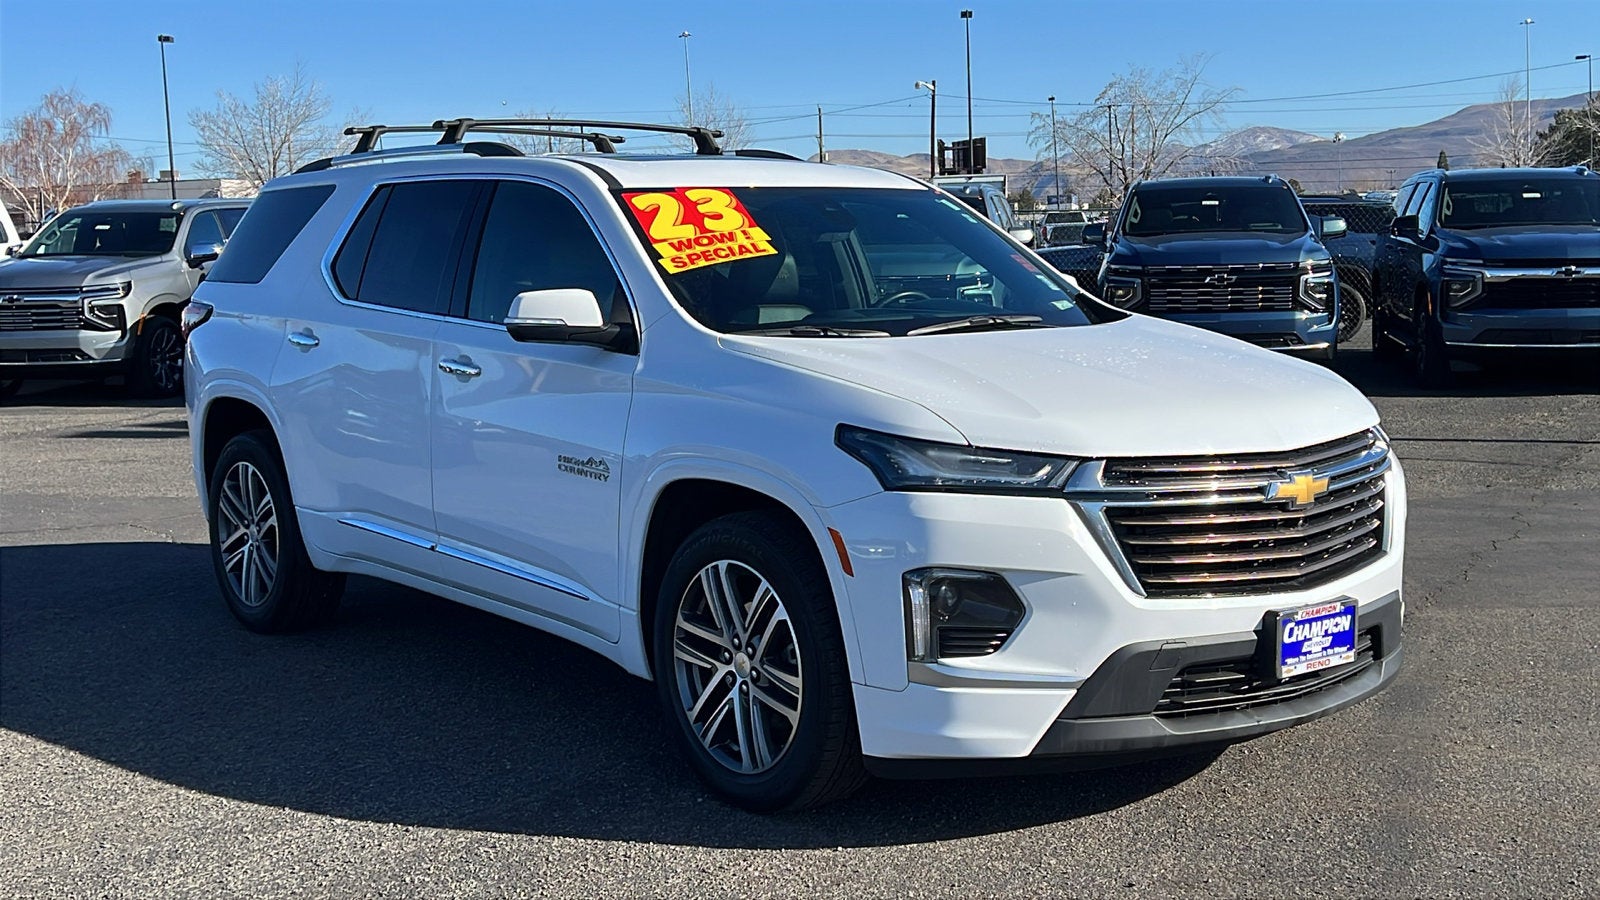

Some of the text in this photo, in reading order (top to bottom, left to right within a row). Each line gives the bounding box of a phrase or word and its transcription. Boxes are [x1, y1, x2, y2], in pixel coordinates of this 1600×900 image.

[631, 188, 750, 240] 23
[670, 243, 767, 269] SPECIAL
[557, 463, 610, 482] COUNTRY
[1301, 605, 1338, 619] CHAMPION
[1283, 615, 1352, 643] CHAMPION
[1306, 658, 1331, 670] RENO
